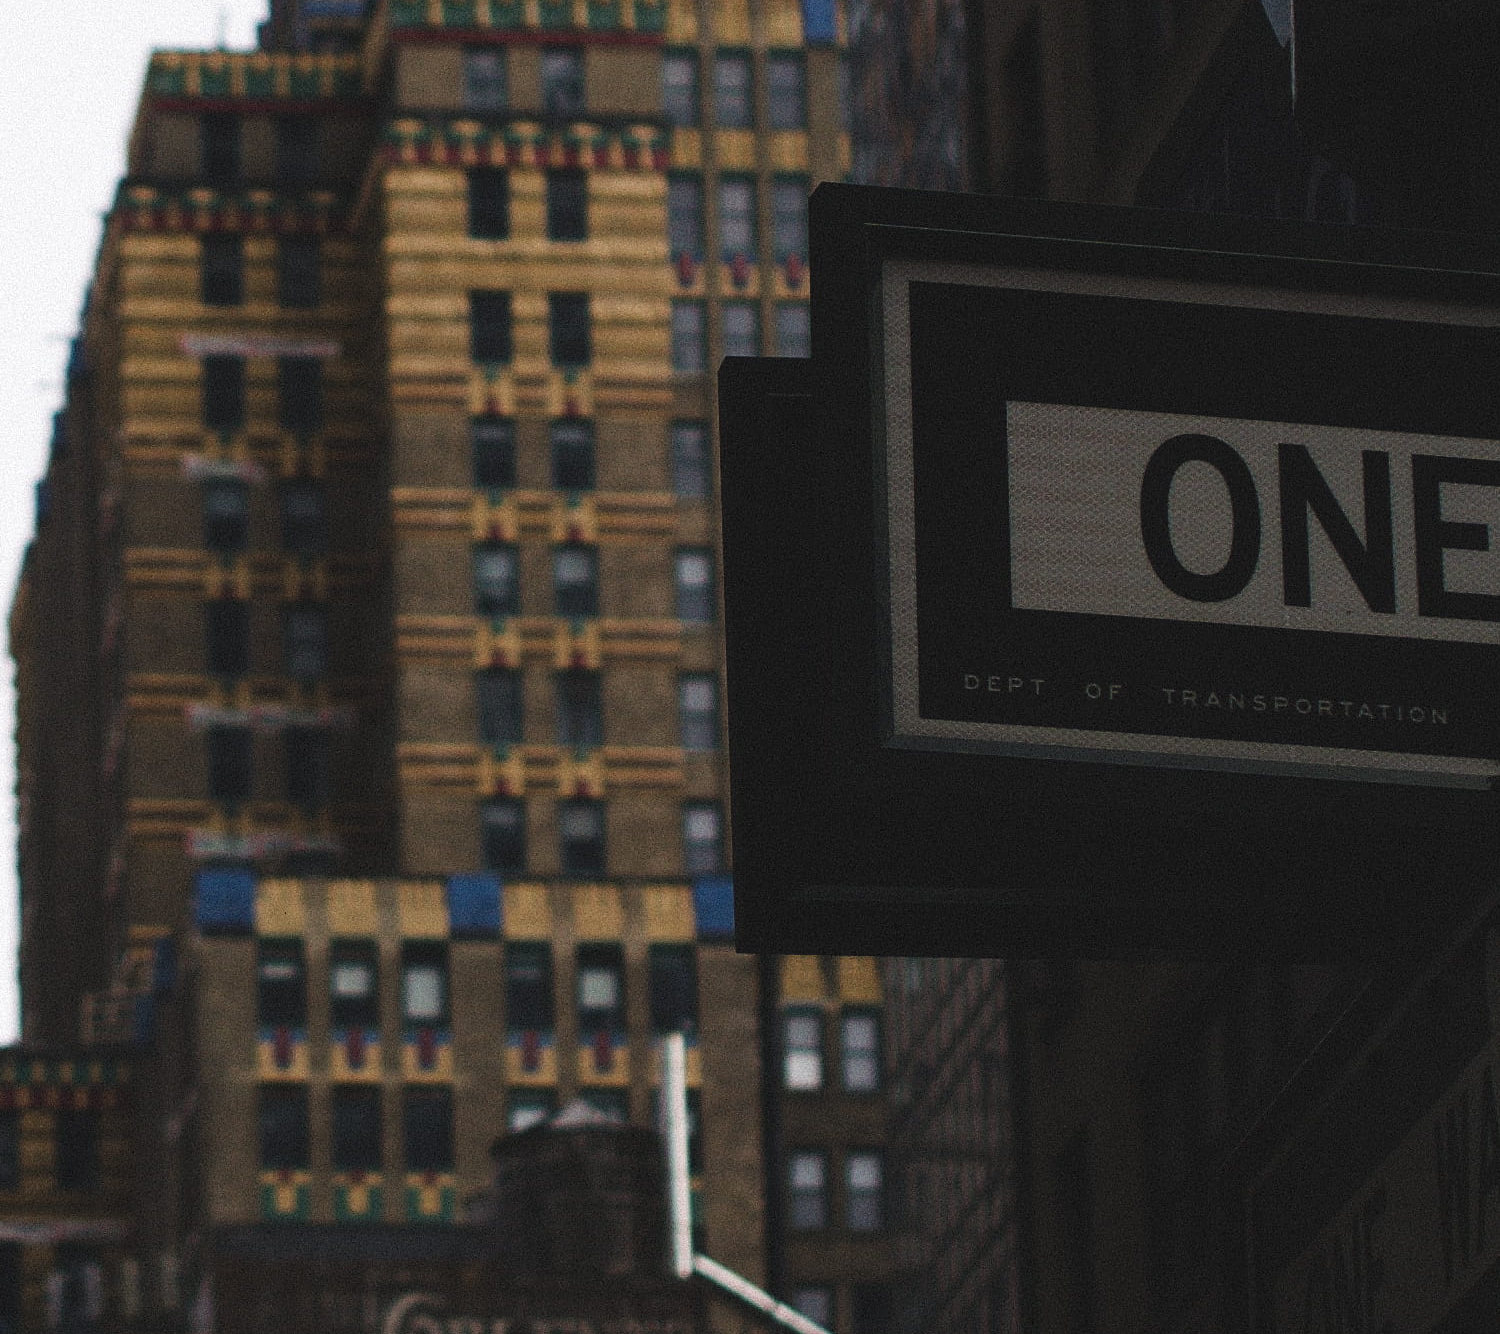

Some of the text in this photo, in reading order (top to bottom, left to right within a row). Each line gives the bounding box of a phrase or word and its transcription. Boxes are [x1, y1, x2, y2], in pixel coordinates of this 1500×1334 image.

[963, 673, 1451, 726] DEPT OF TRANSPORTATION
